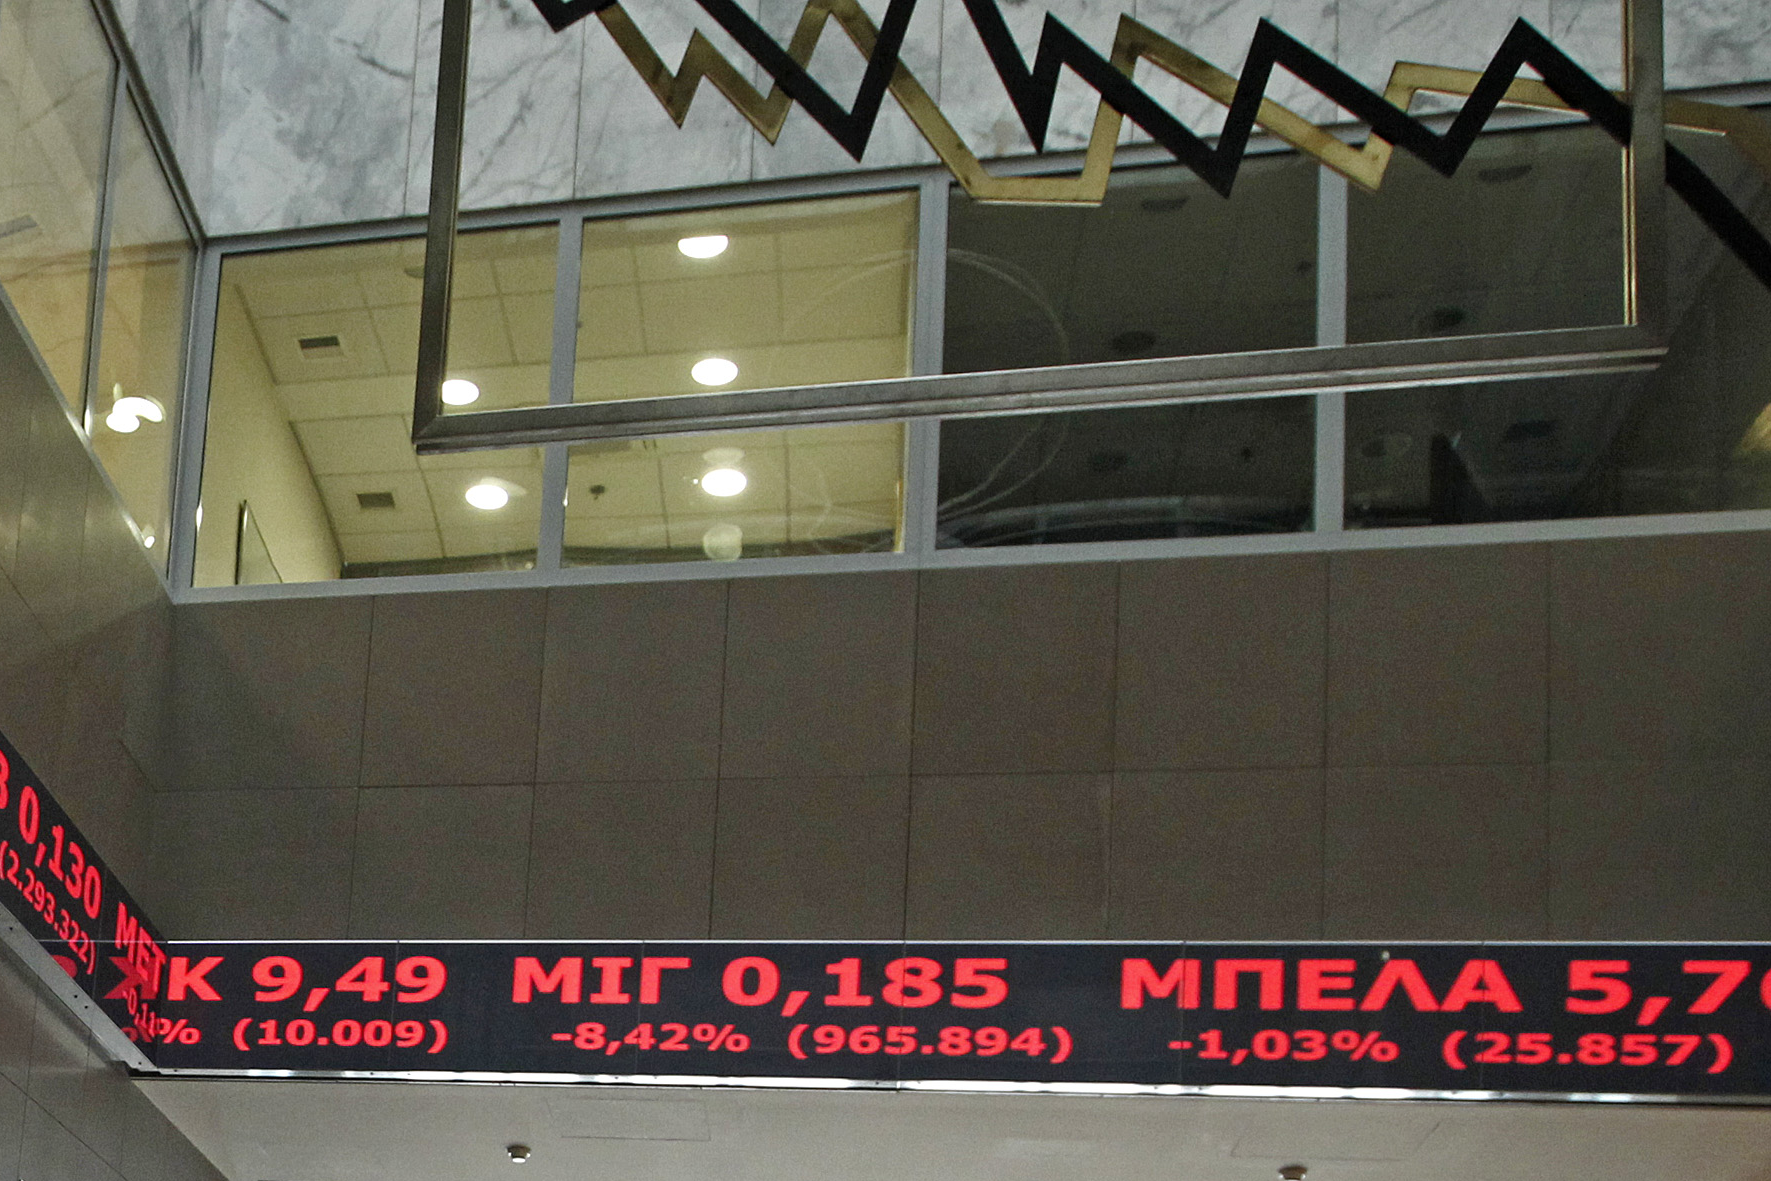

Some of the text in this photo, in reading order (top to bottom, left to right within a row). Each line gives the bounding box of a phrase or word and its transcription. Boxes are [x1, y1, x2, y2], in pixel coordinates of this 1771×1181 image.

[18, 785, 102, 919] 0,130
[251, 955, 448, 1013] 9,49
[512, 956, 692, 1005] ΜΙΓ
[722, 956, 1009, 1018] 0,185
[1120, 957, 1523, 1013] ΜΠΕΛΑ
[1565, 959, 1771, 1027] 5,7
[232, 1017, 449, 1054] (10.009)
[551, 1021, 751, 1056] -8,42%
[787, 1023, 1073, 1064] (965.894)
[1168, 1029, 1400, 1066] -1,03%
[1442, 1030, 1734, 1074] (25.857)
